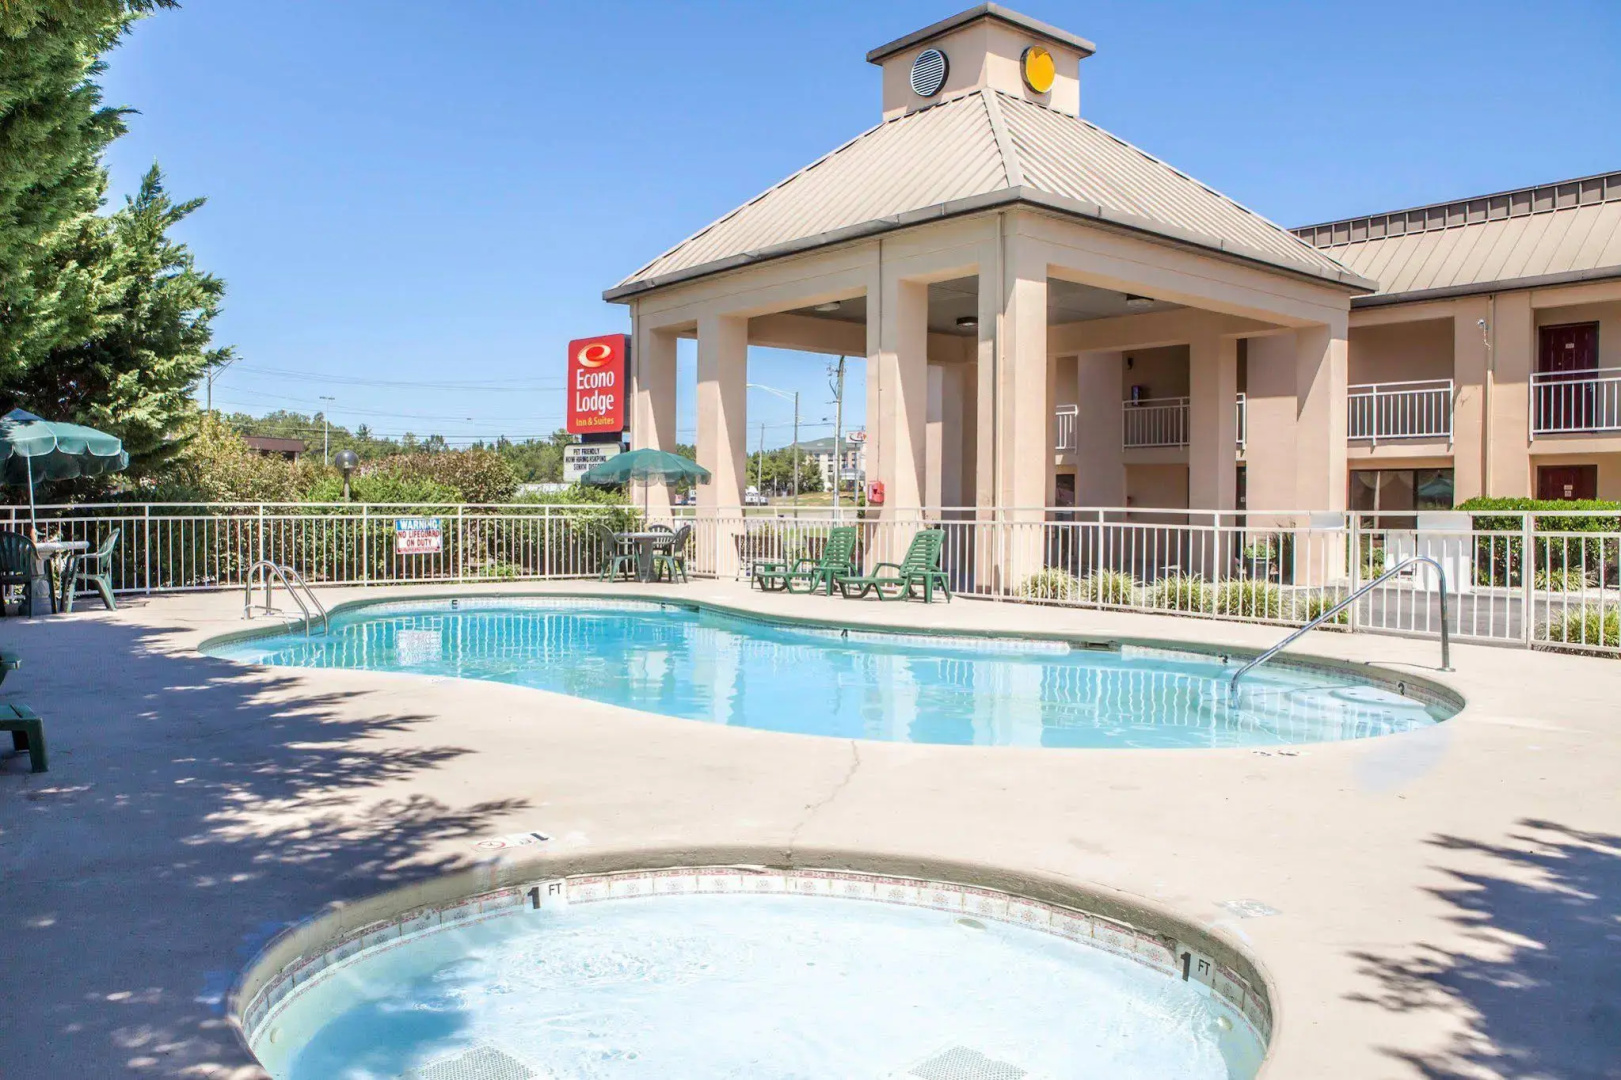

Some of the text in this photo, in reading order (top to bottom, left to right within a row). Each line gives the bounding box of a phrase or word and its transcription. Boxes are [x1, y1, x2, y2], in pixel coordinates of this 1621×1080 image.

[576, 368, 615, 390] Econo
[575, 389, 615, 416] Lodge
[575, 415, 615, 427] Inn & Suites
[581, 447, 600, 455] FRIENDLY
[400, 519, 439, 530] WARNING
[397, 530, 440, 539] NO LIFEGUARD
[406, 538, 432, 547] ON DUTY
[527, 882, 562, 910] 1 FT
[1180, 951, 1211, 983] 1 FT
